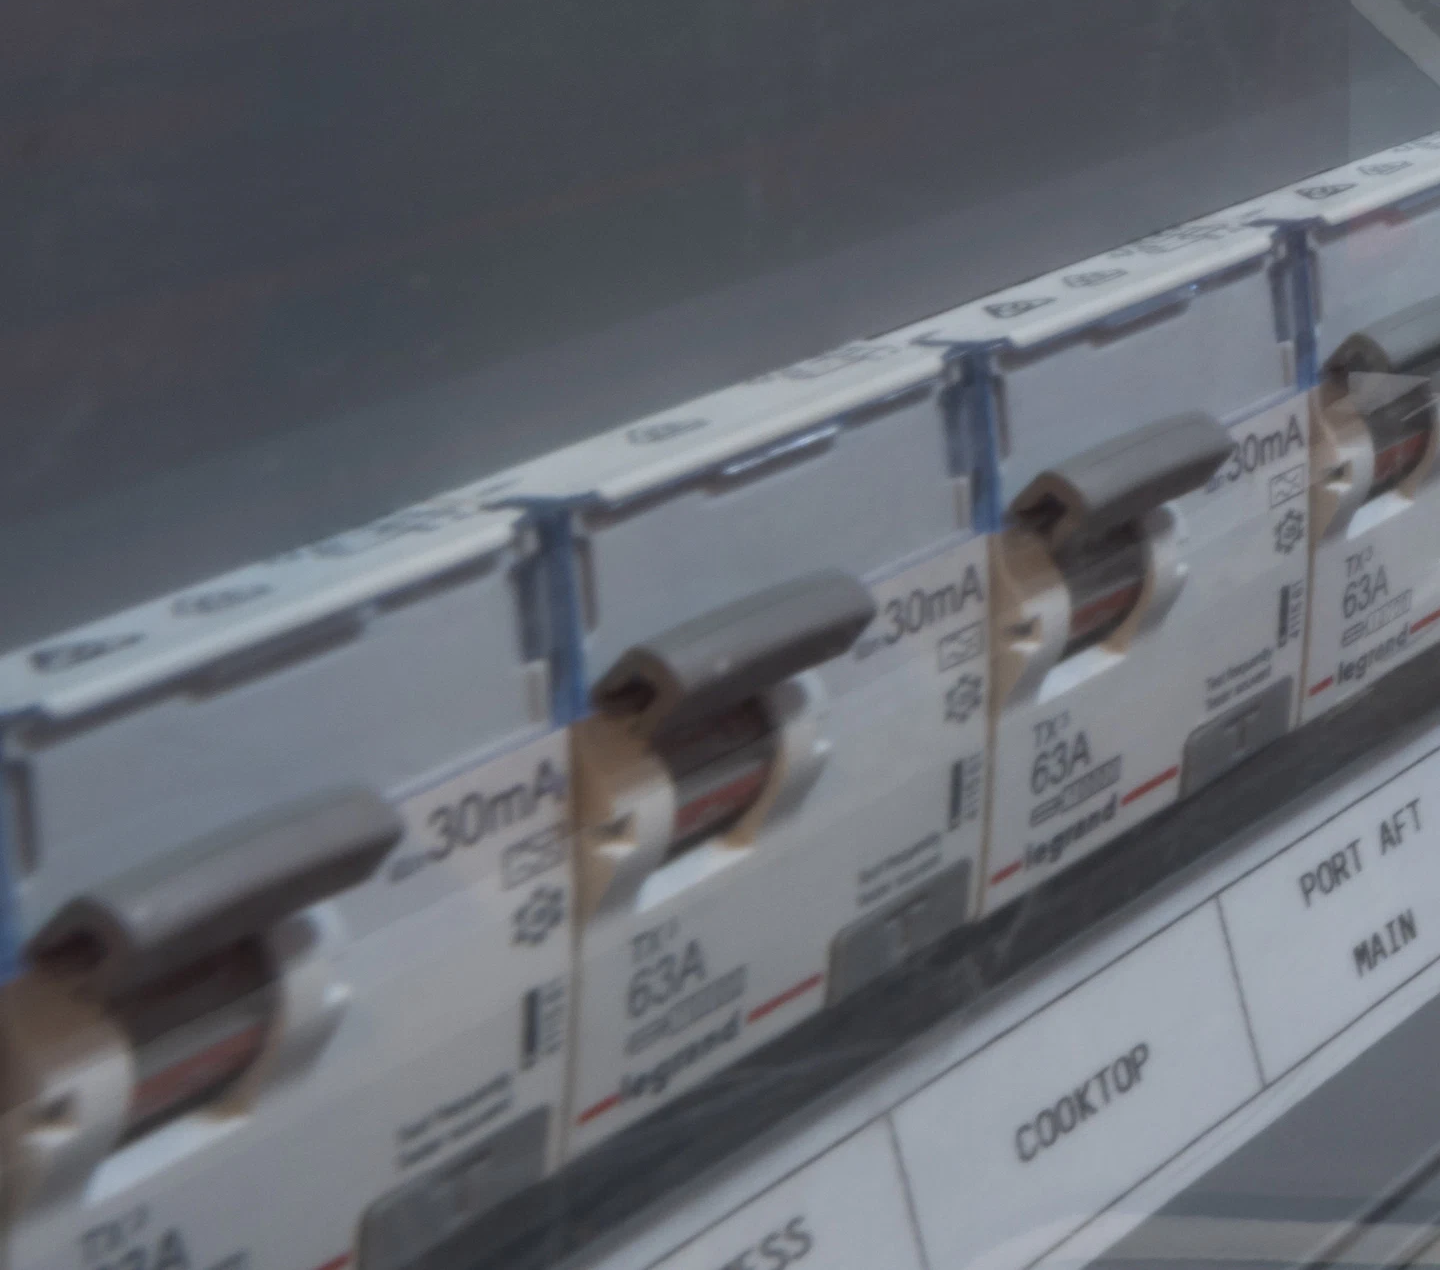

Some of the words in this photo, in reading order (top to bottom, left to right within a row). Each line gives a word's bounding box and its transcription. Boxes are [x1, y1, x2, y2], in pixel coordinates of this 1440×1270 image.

[885, 563, 984, 645] 30mA
[1343, 564, 1389, 619] 63A
[1338, 621, 1410, 685] legrand
[1030, 730, 1090, 795] 63A
[427, 757, 568, 863] 30mA
[1025, 792, 1118, 871] legrand
[1298, 838, 1363, 908] PORT
[1379, 796, 1422, 856] AFT
[627, 938, 706, 1019] 63A
[1352, 909, 1418, 978] MAIN
[618, 1010, 740, 1101] legrand
[1013, 1042, 1149, 1164] COOKTOP
